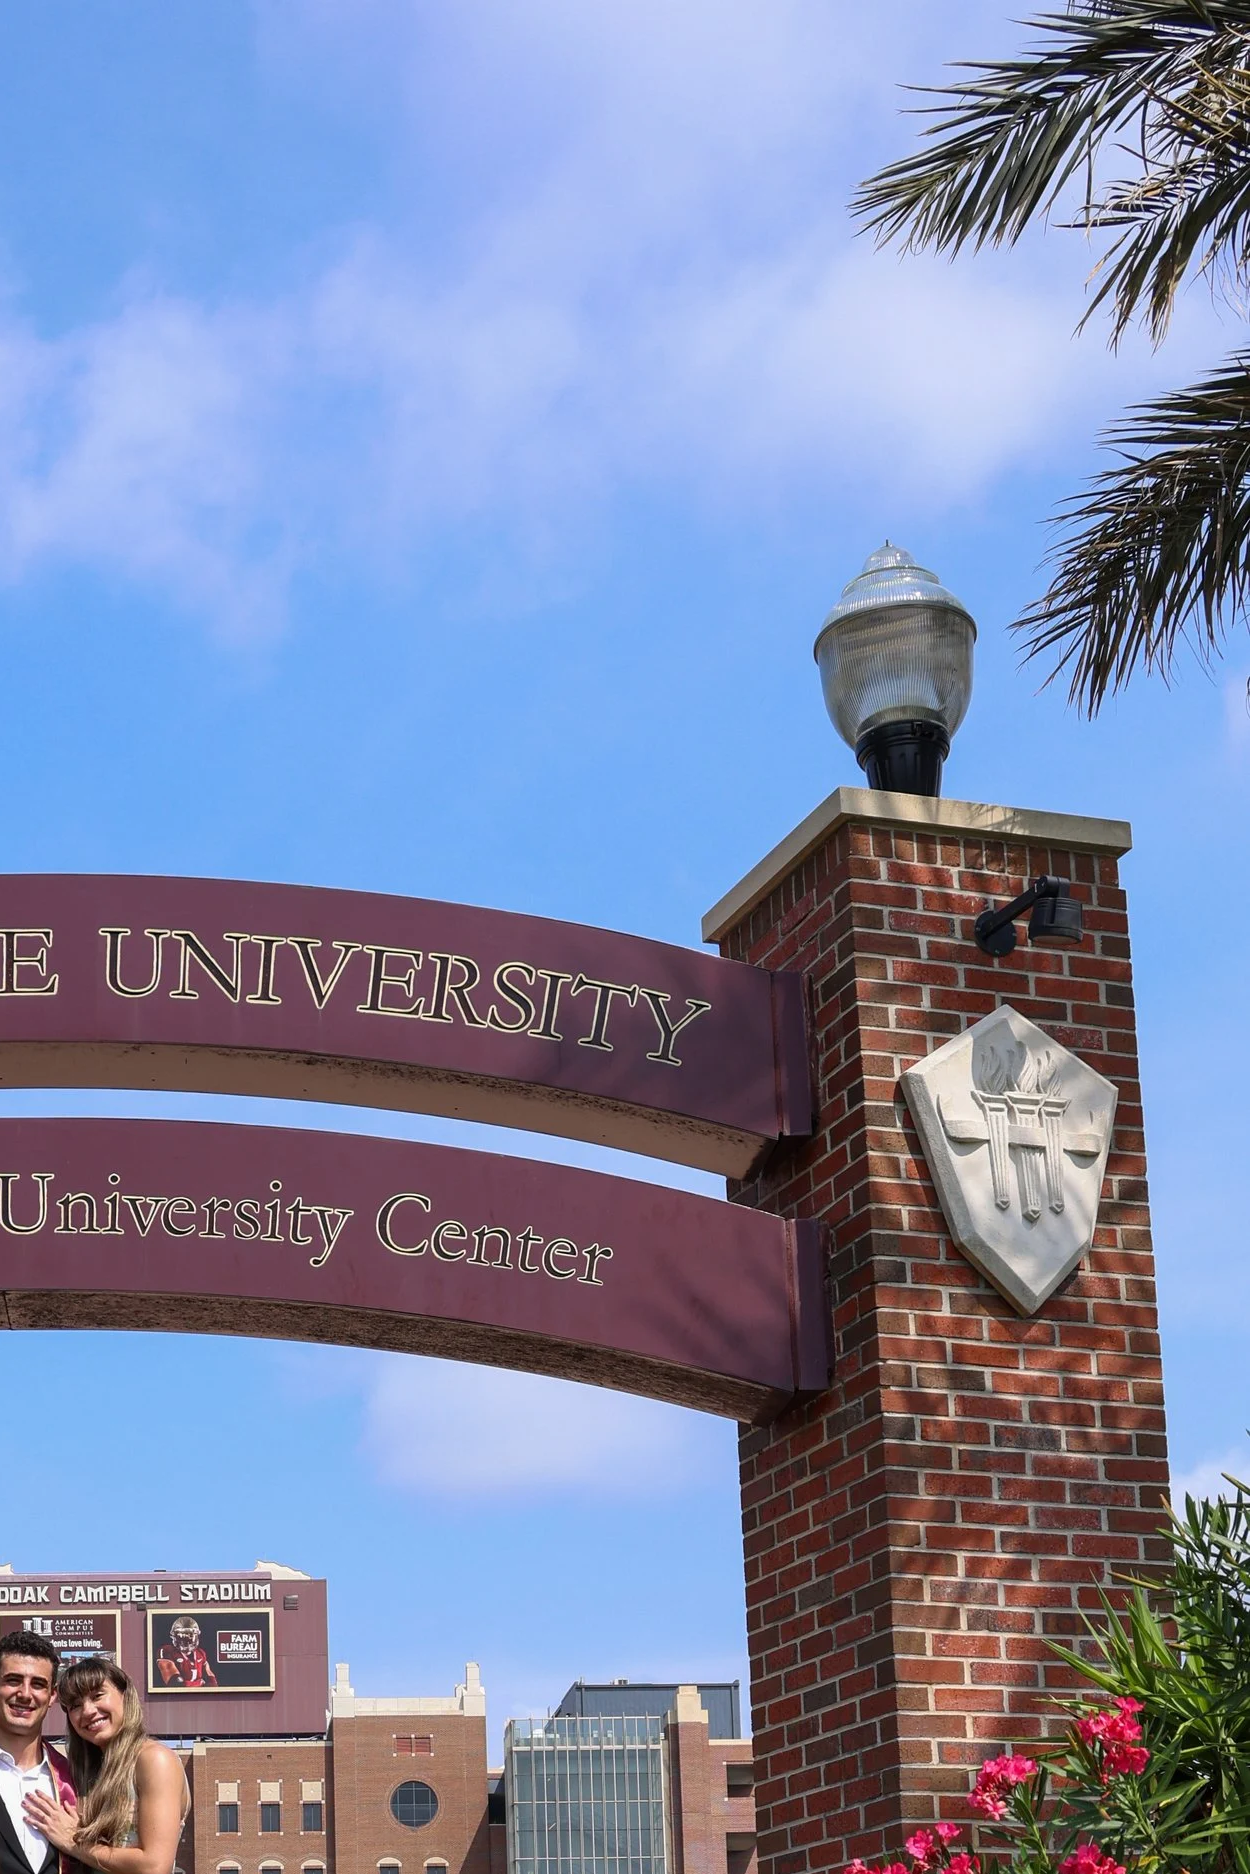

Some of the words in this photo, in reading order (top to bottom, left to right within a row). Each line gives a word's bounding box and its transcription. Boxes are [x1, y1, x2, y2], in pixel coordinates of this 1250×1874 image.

[98, 927, 712, 1067] UNIVERSITY
[375, 1192, 615, 1286] Center
[60, 1584, 170, 1603] CAMPBELL
[180, 1583, 272, 1601] STADIUM
[68, 1638, 82, 1648] love
[231, 1634, 258, 1643] FARM
[220, 1643, 258, 1652] BUREAU
